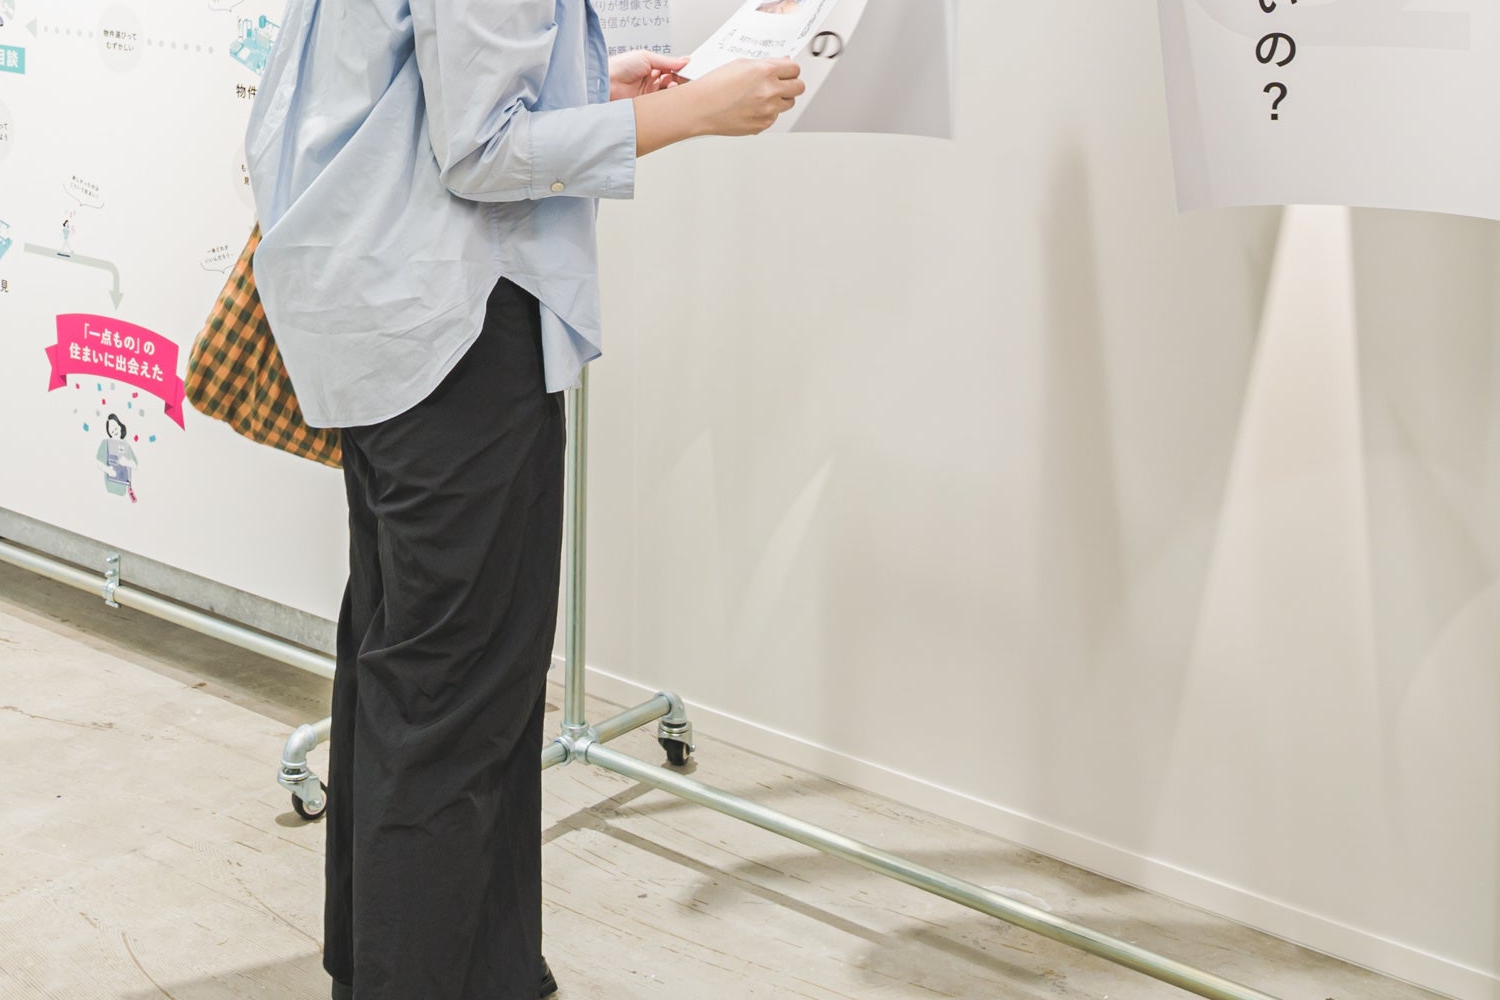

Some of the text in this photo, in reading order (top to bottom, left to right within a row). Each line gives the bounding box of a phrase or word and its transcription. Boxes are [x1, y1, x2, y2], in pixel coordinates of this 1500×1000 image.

[83, 323, 155, 355] 「一点もの」の
[68, 343, 164, 382] 住まいに出会えた
